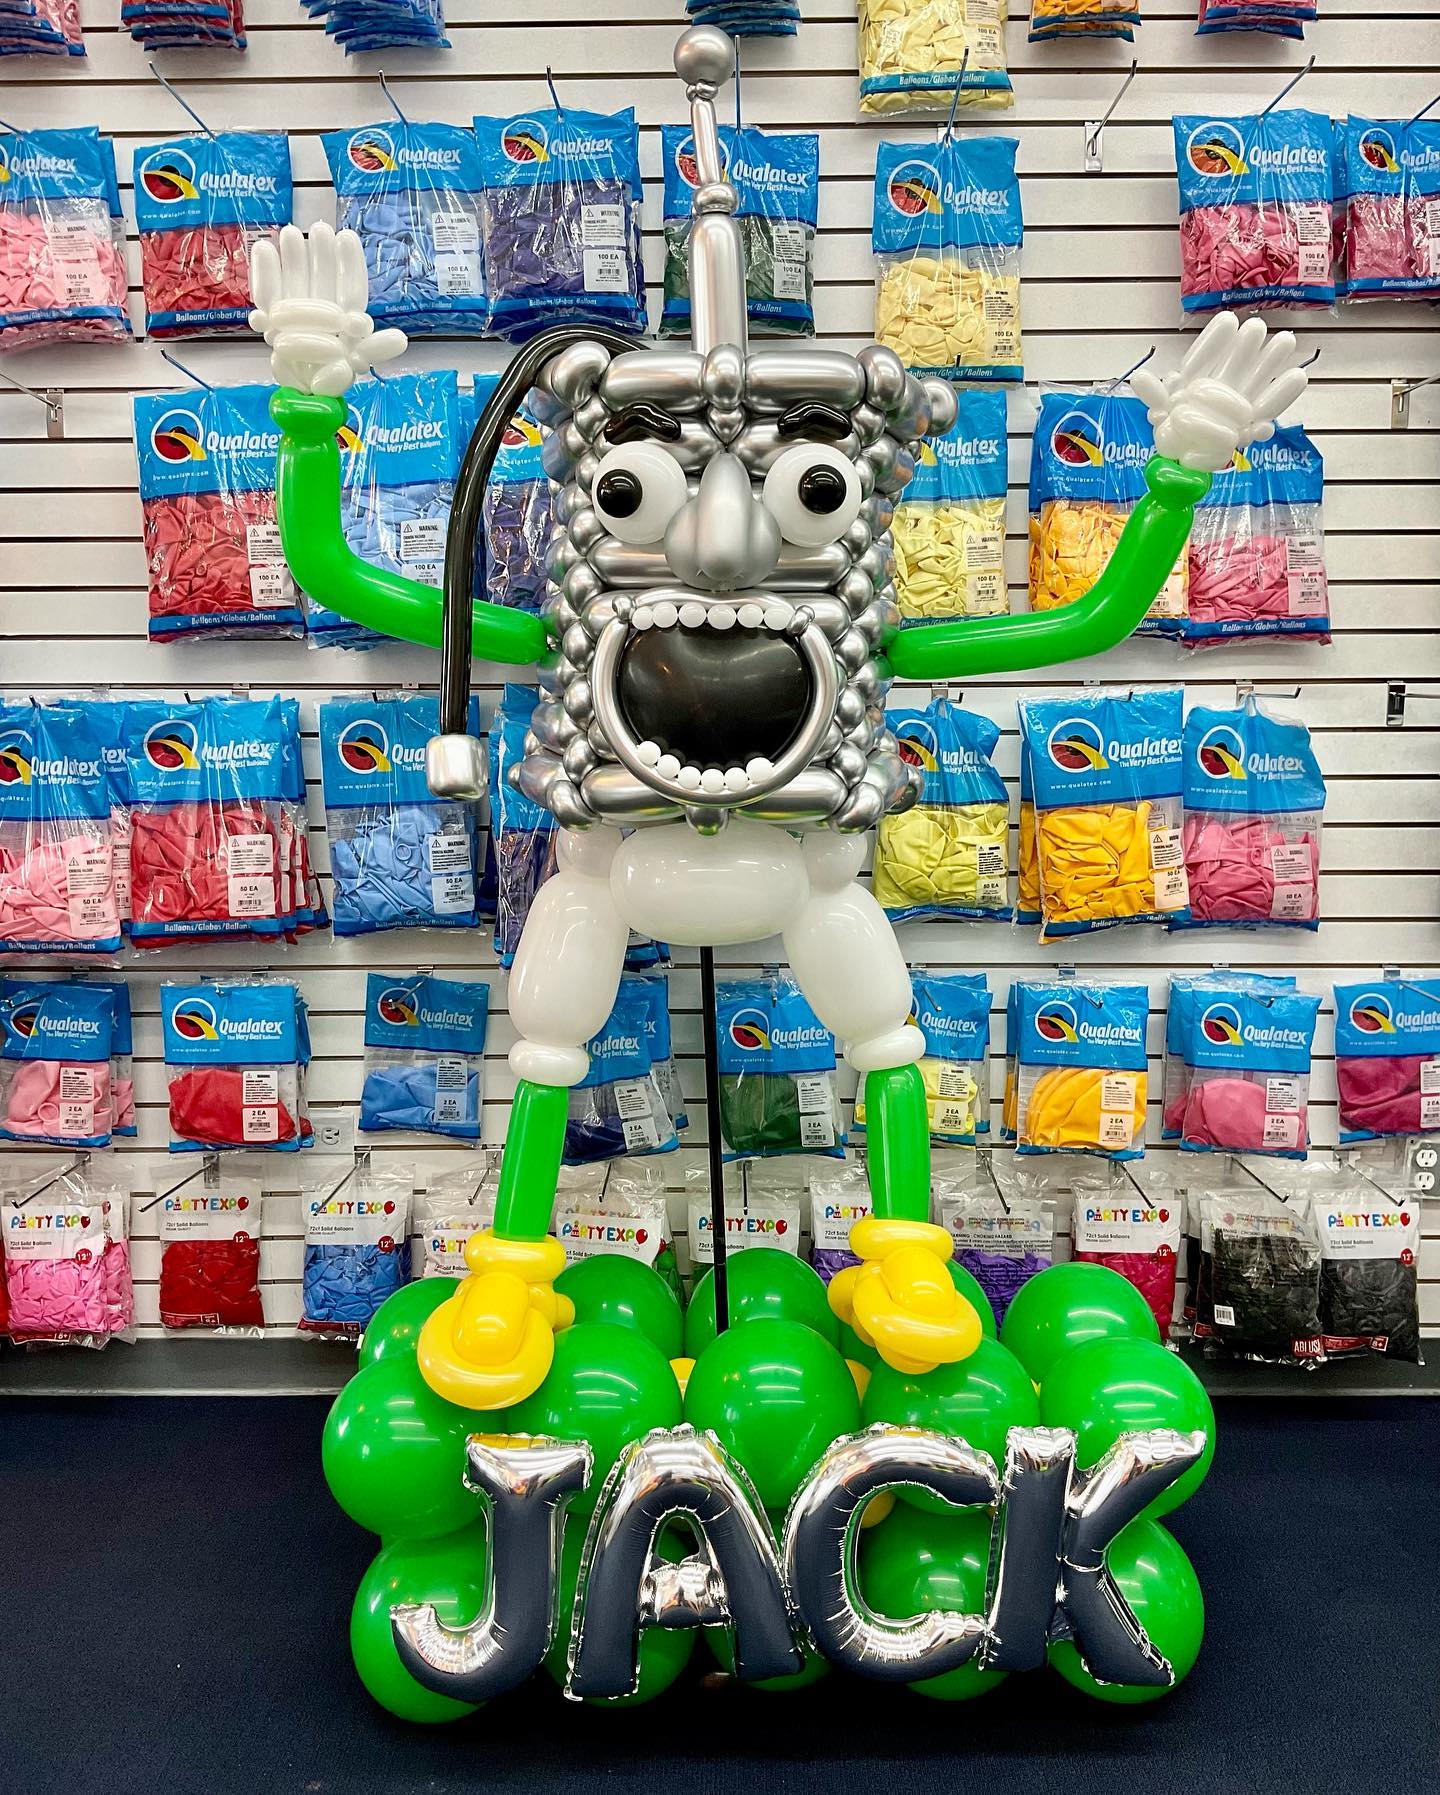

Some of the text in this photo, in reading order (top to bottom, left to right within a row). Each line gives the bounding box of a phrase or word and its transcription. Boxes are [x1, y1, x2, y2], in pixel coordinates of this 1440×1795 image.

[398, 146, 461, 165] Qualatex
[1250, 144, 1328, 169] Qualatex
[732, 159, 809, 188] Qualatex
[366, 420, 444, 444] Qualatex
[229, 450, 247, 460] Very
[386, 442, 403, 454] Very
[403, 441, 420, 452] Best
[960, 456, 975, 465] Best
[1108, 736, 1183, 762] Qualatex
[31, 756, 100, 778] Qualatex
[1119, 756, 1164, 769] The Very Best
[48, 776, 66, 786] Very
[40, 1016, 100, 1034] Qualatex
[220, 1018, 282, 1035] Qualatex
[420, 1008, 473, 1028] Qualatex
[921, 1012, 978, 1034] Qualatex
[235, 1034, 250, 1042] Very
[771, 1027, 830, 1044] Qualatex
[1080, 1022, 1142, 1042] Qualatex
[1244, 1025, 1306, 1044] Qualatex
[786, 1042, 800, 1050] Very
[1094, 1038, 1121, 1046] Very Best
[164, 1196, 209, 1210] PARTY
[825, 1203, 868, 1219] PARTY
[10, 1213, 52, 1229] PARTY
[1086, 1207, 1128, 1222] PARTY
[1328, 1211, 1370, 1228] PARTY
[562, 1220, 605, 1240] PARTY
[391, 1422, 1207, 1702] JACK
